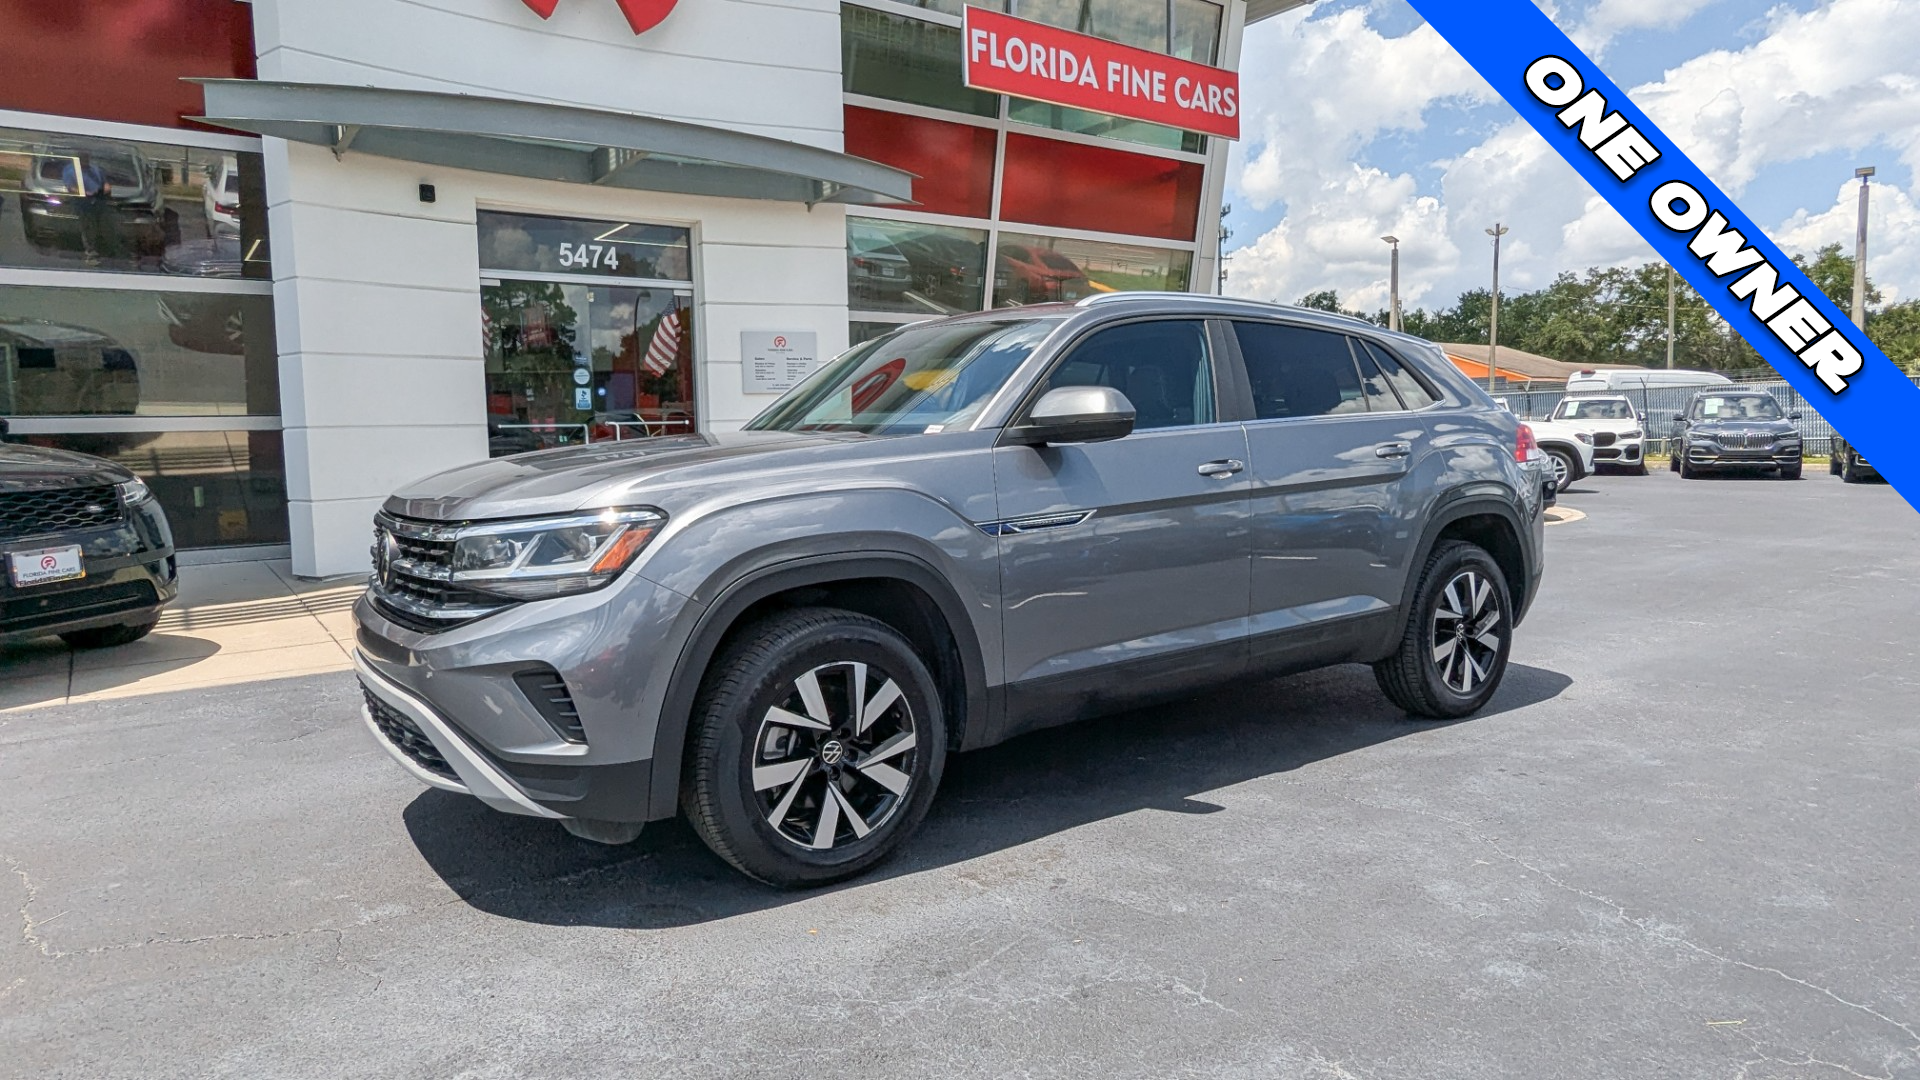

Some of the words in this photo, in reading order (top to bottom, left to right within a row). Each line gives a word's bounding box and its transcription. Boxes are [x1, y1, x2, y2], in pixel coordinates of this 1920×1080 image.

[971, 28, 1099, 89] FLORIDA
[1107, 61, 1166, 103] FINE
[1174, 76, 1237, 117] CARS
[559, 242, 619, 270] 5474
[23, 570, 46, 578] FLORIDA
